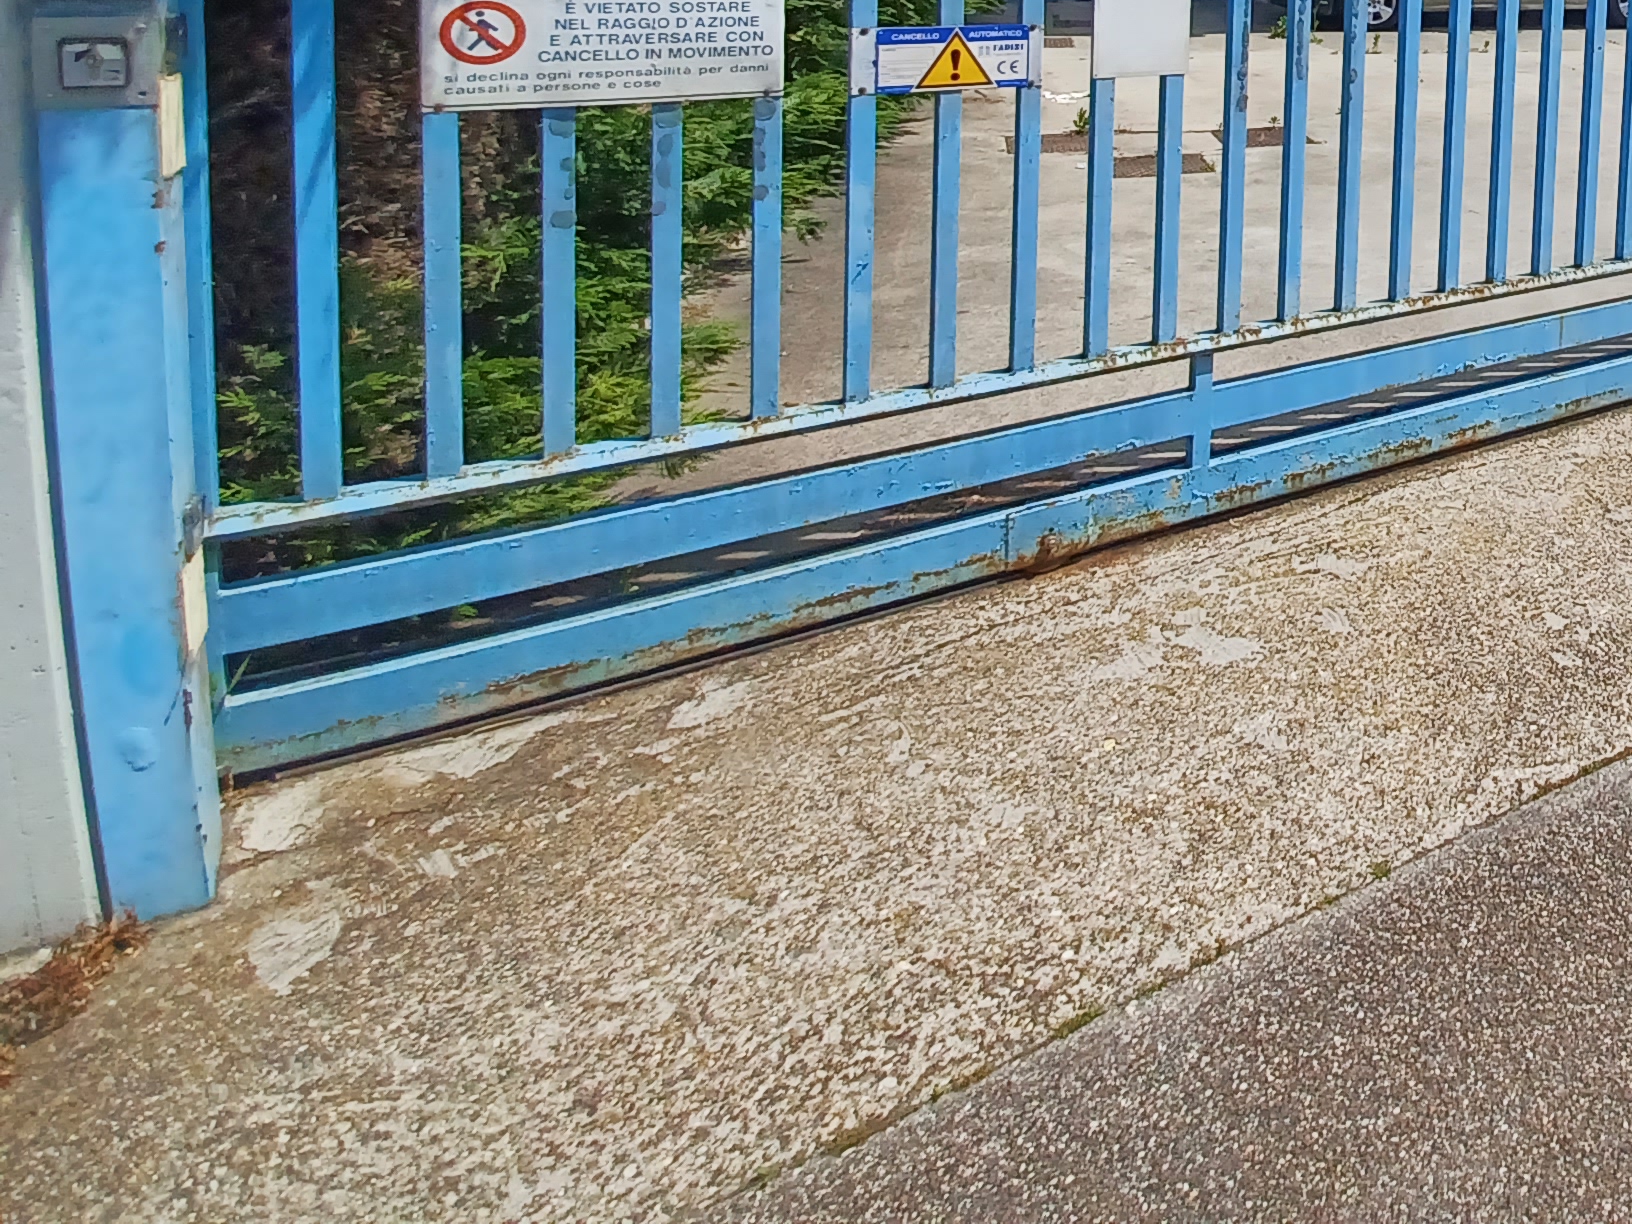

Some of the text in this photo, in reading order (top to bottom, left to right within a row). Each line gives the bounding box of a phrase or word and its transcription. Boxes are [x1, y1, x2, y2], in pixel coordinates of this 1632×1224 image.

[584, 1, 661, 14] VIETATO
[669, 1, 751, 13] SOSTARE
[554, 18, 591, 31] NEL
[597, 17, 670, 30] RAGGIO
[550, 30, 765, 47] E ATTRAVERSARE CON
[891, 29, 1023, 41] CANCELLO AUTOMATICO
[537, 44, 774, 63] CANCELLO IN MOVIMENTO
[444, 63, 769, 83] si declina ogni responsabilità per danni
[444, 79, 662, 96] causati a persone e cose
